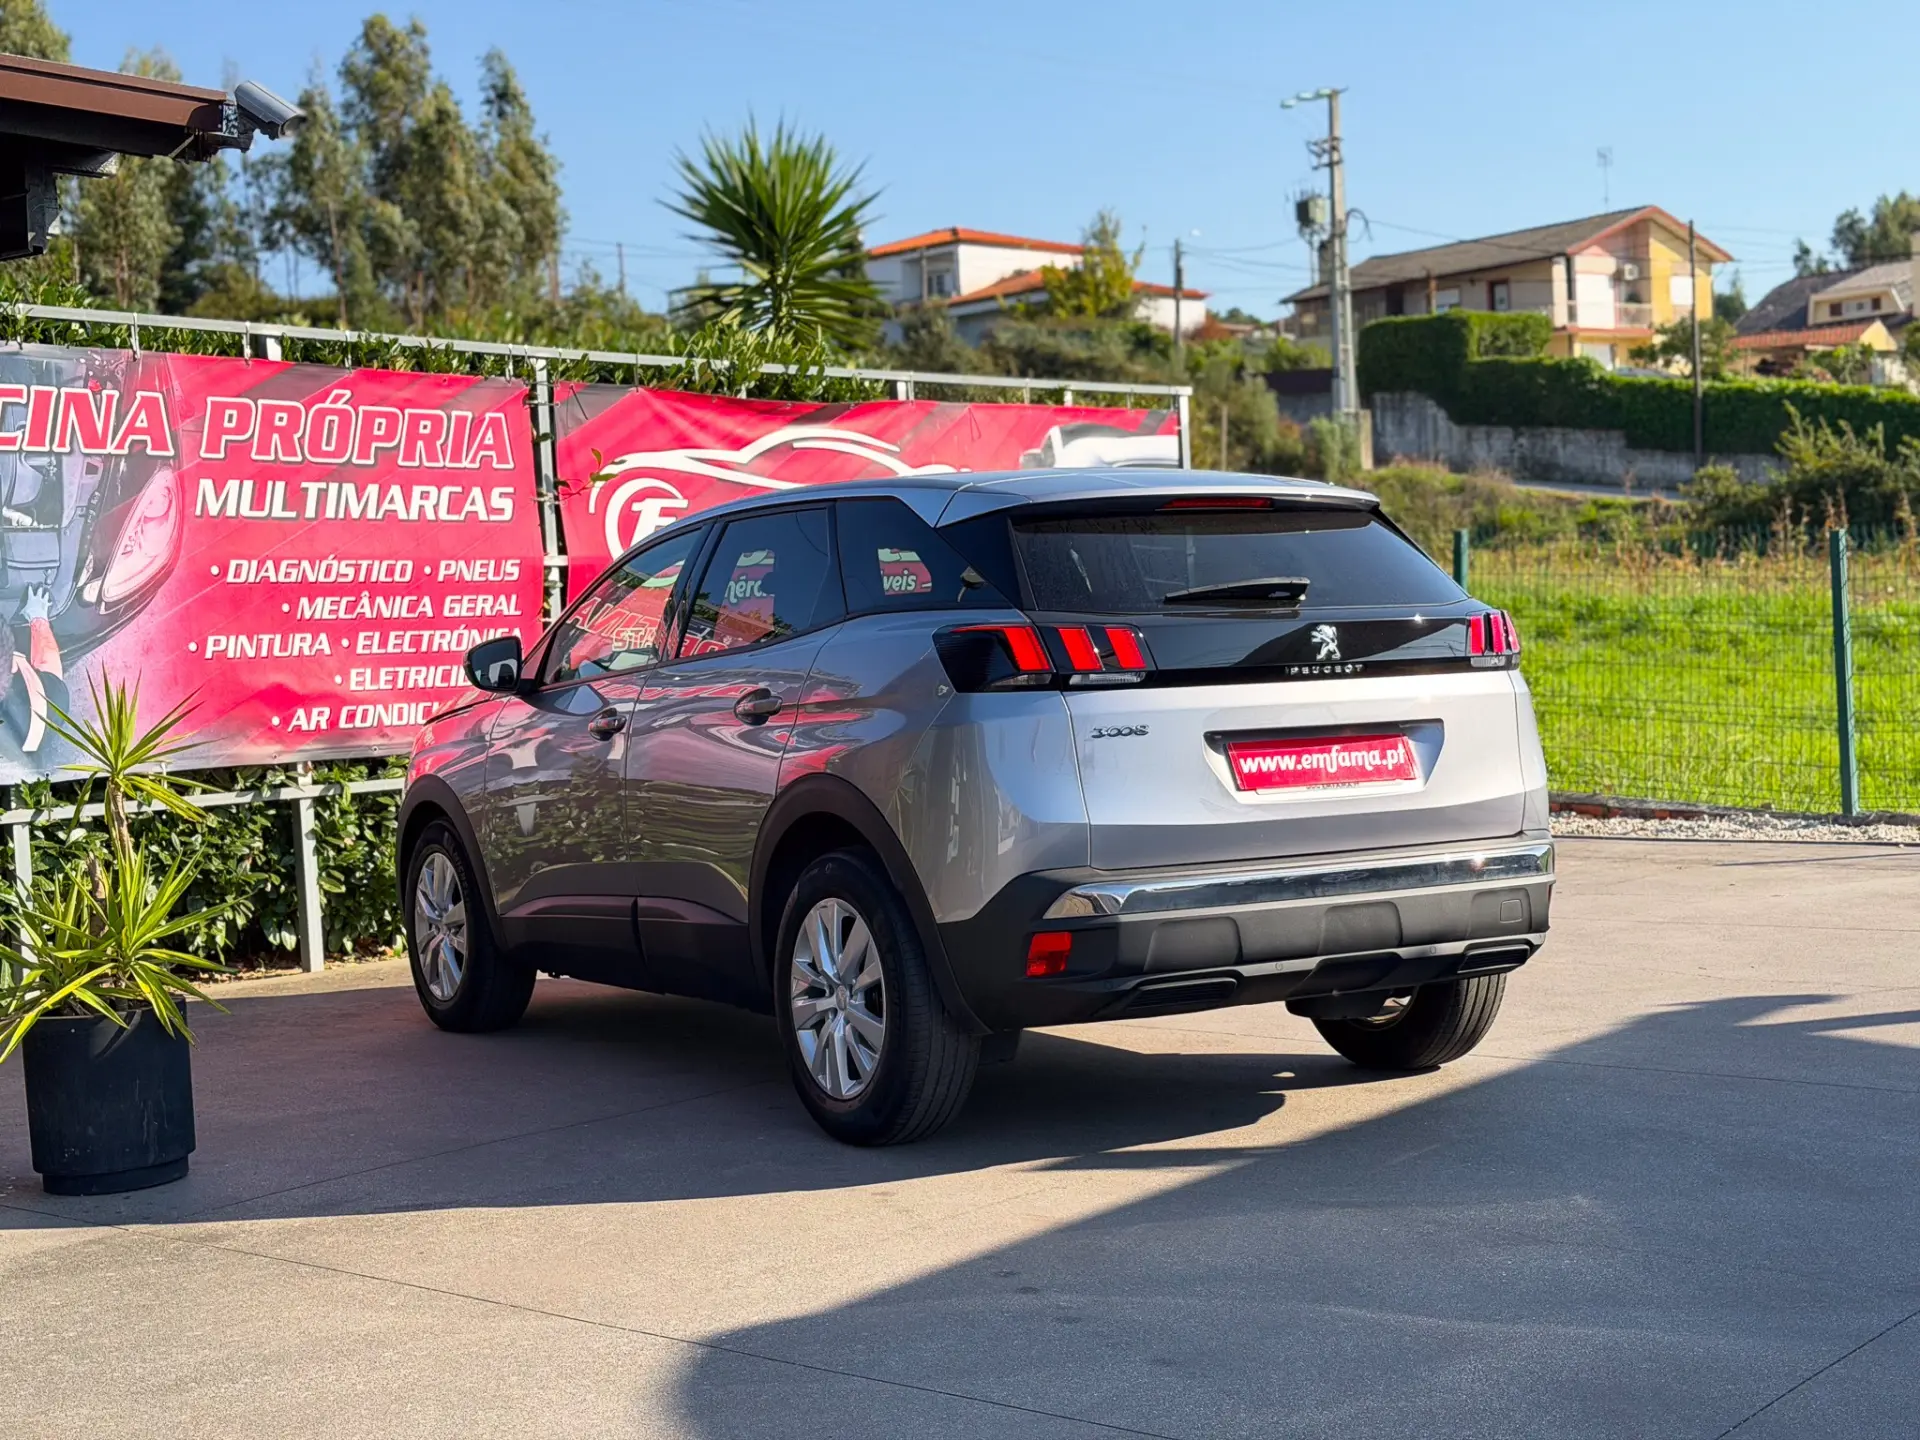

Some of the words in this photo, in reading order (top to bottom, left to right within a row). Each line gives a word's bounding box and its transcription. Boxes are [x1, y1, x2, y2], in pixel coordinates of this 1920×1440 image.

[199, 389, 516, 470] PRÓPRIA
[194, 478, 515, 522] MULTIMARCAS
[226, 554, 414, 584] DIAGNÓSTICO
[437, 559, 522, 583] PNEUS
[296, 590, 435, 621] MECÂNICA
[443, 594, 523, 618] GERAL
[204, 632, 332, 660] PINTURA
[1290, 664, 1363, 676] PEUGEOT
[287, 706, 332, 732] AR
[1091, 725, 1149, 739] 3008
[1239, 743, 1407, 775] www.emfama.pt
